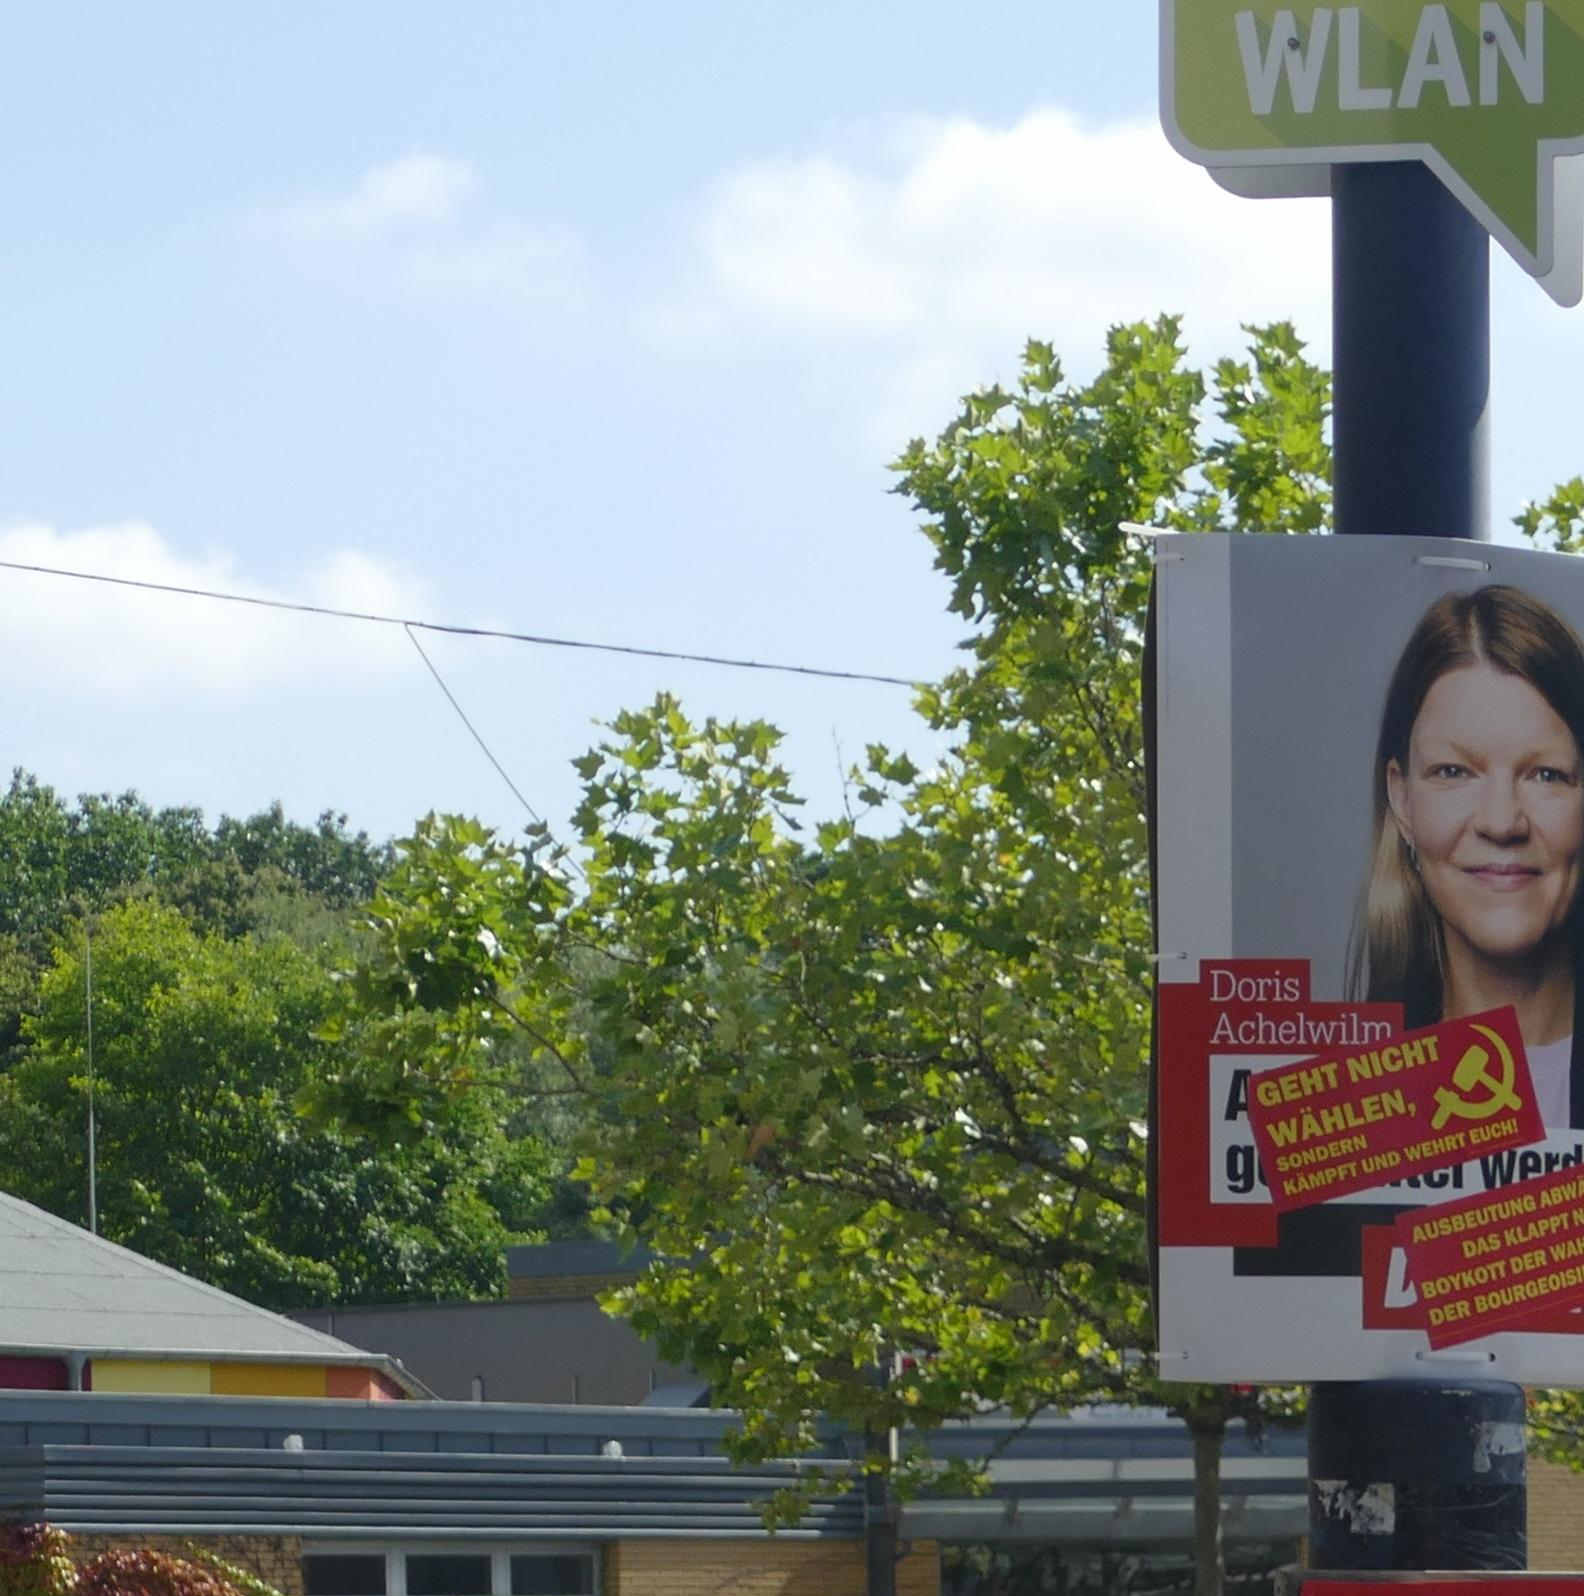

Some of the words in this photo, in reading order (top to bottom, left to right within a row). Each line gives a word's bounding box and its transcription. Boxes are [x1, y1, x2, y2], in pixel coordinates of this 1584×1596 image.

[1235, 1, 1544, 115] WLAN
[1209, 969, 1301, 1002] Doris
[1209, 1011, 1392, 1045] Achelwilm
[1256, 1062, 1340, 1107] GEHT
[1349, 1035, 1440, 1084] NICHT
[1266, 1089, 1417, 1148] WÄHLEN,
[1276, 1135, 1368, 1173] SONDERN
[1283, 1160, 1358, 1196] KÄMPFT
[1362, 1152, 1400, 1178] UND
[1403, 1132, 1465, 1162] WEHRT
[1470, 1118, 1519, 1145] EUCH!
[1412, 1194, 1537, 1244] AUSBEUTUNG
[1462, 1233, 1501, 1258] DAS
[1504, 1213, 1570, 1246] KLAPPT
[1420, 1260, 1507, 1299] BOYKOTT
[1510, 1249, 1548, 1274] DER
[1428, 1300, 1471, 1325] DER
